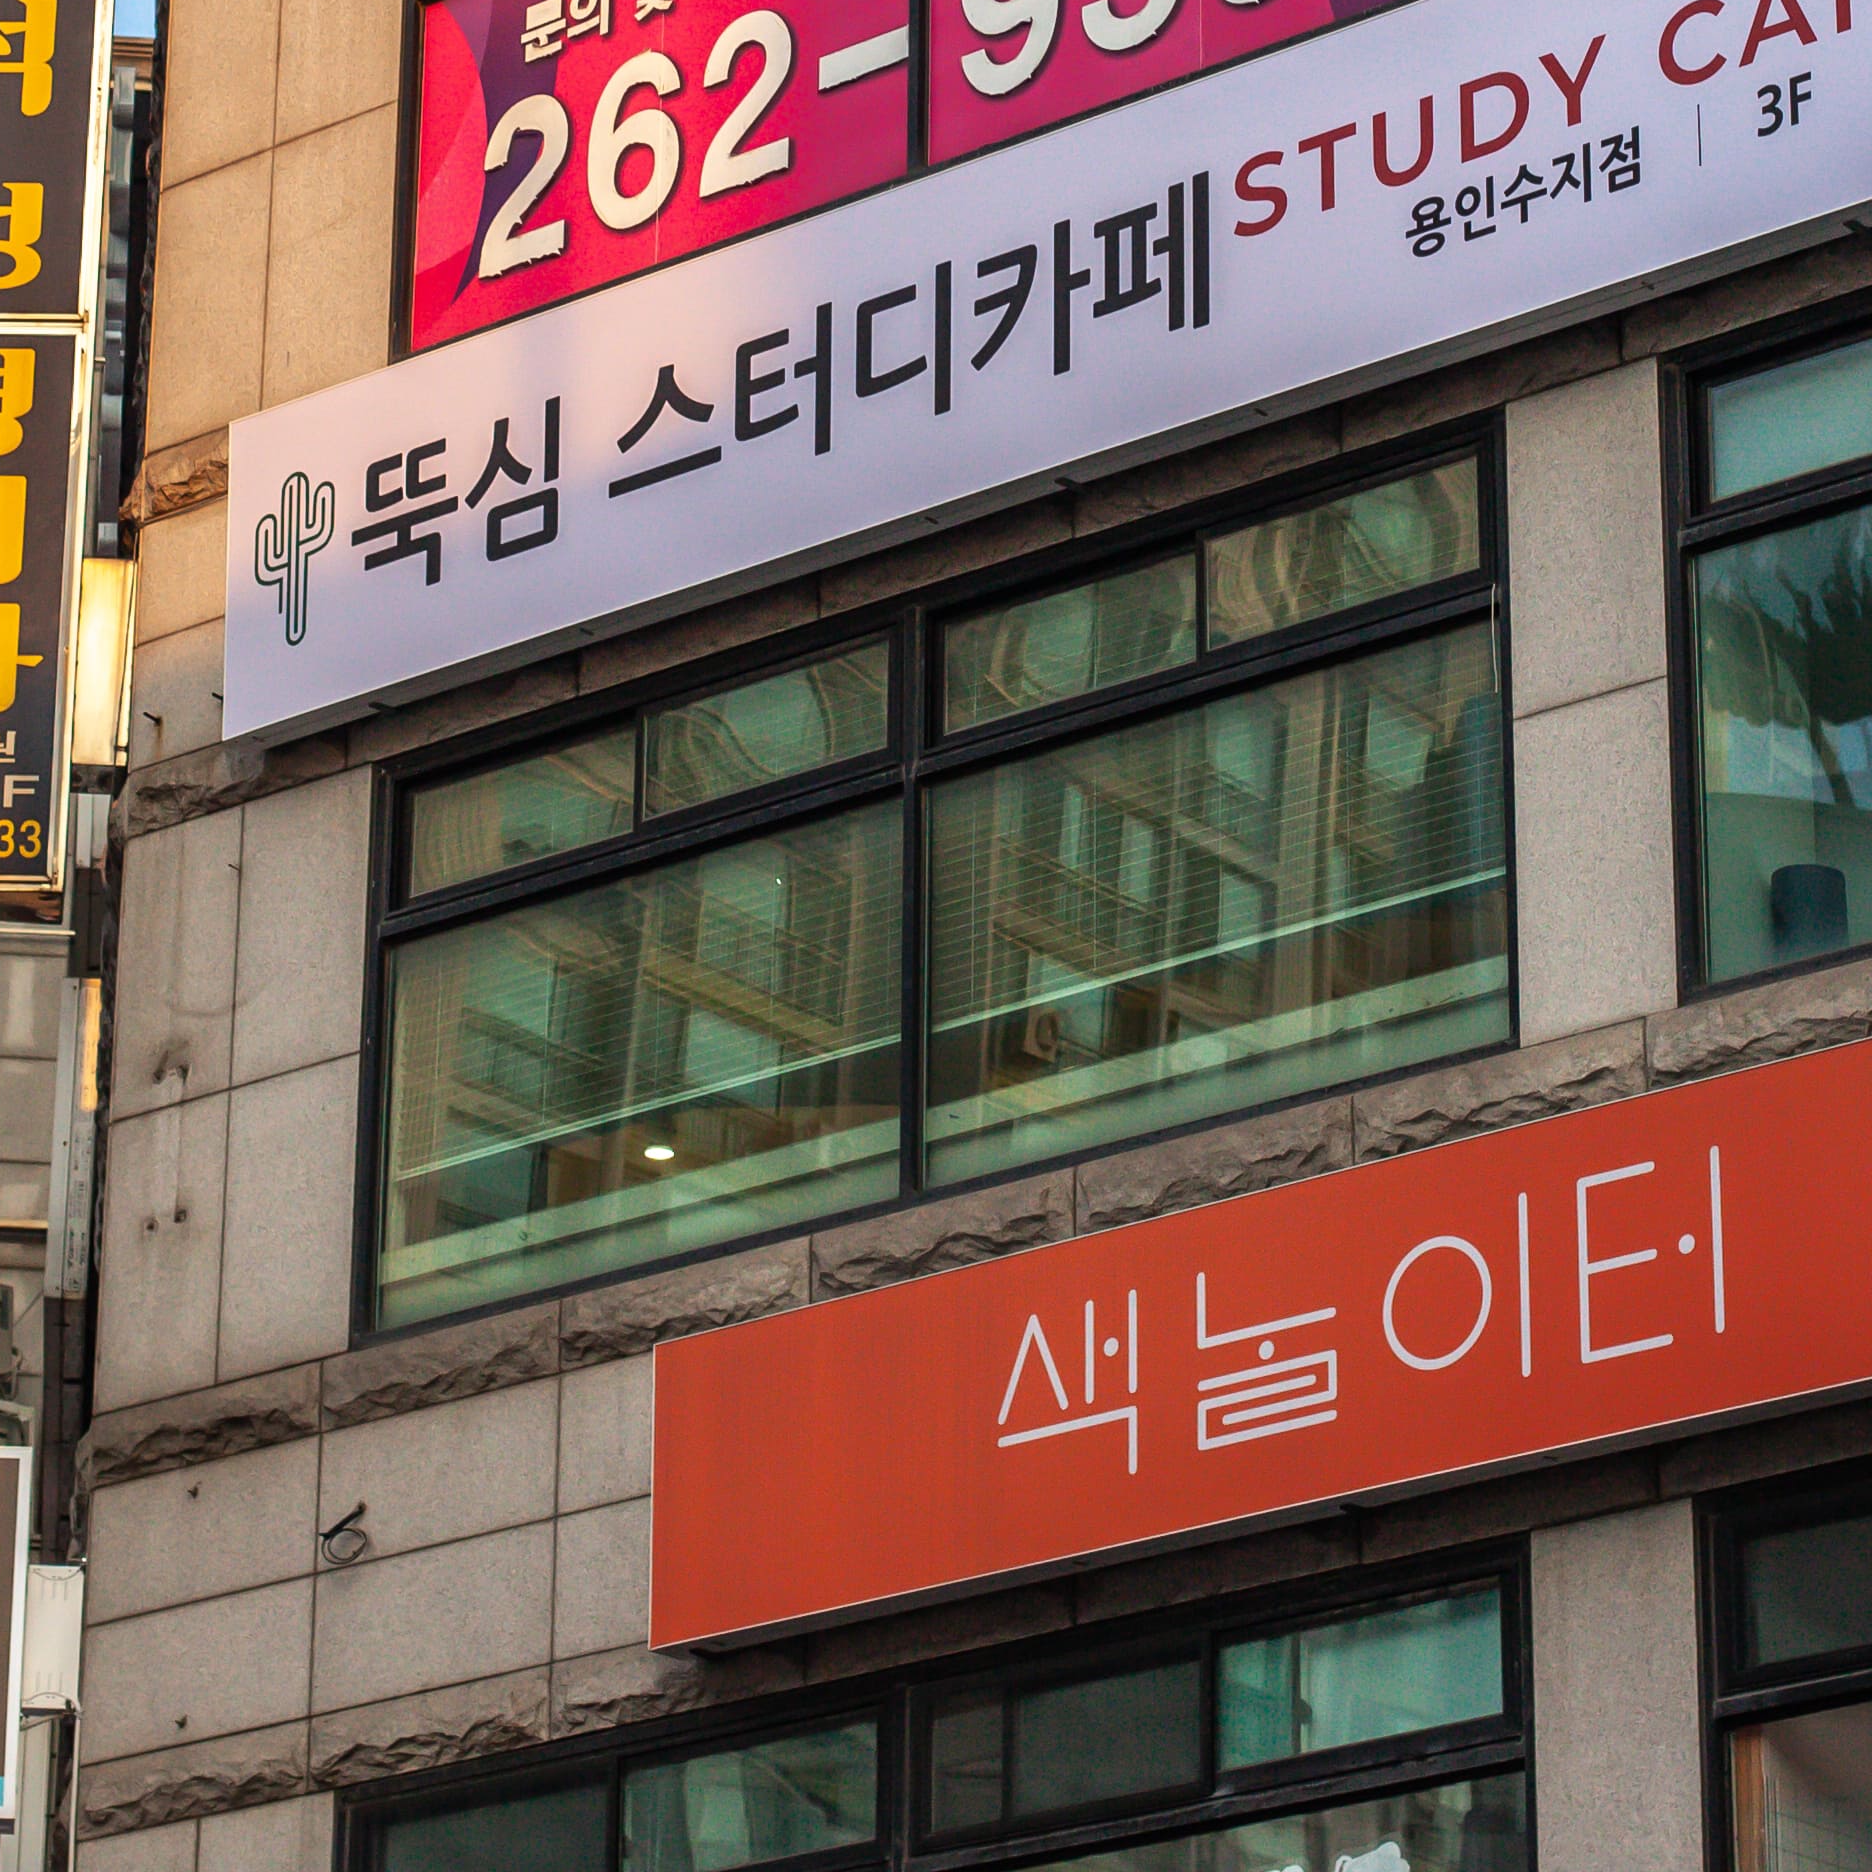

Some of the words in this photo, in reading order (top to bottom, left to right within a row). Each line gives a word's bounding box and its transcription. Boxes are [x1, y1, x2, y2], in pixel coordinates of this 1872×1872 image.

[1232, 33, 1607, 238] STUDY
[1404, 126, 1643, 259] 용인수지점
[1756, 71, 1813, 138] 3F
[351, 394, 562, 586] 뚝심
[608, 169, 1212, 500] 스터디카페
[996, 1144, 1725, 1475] 색놀이터
